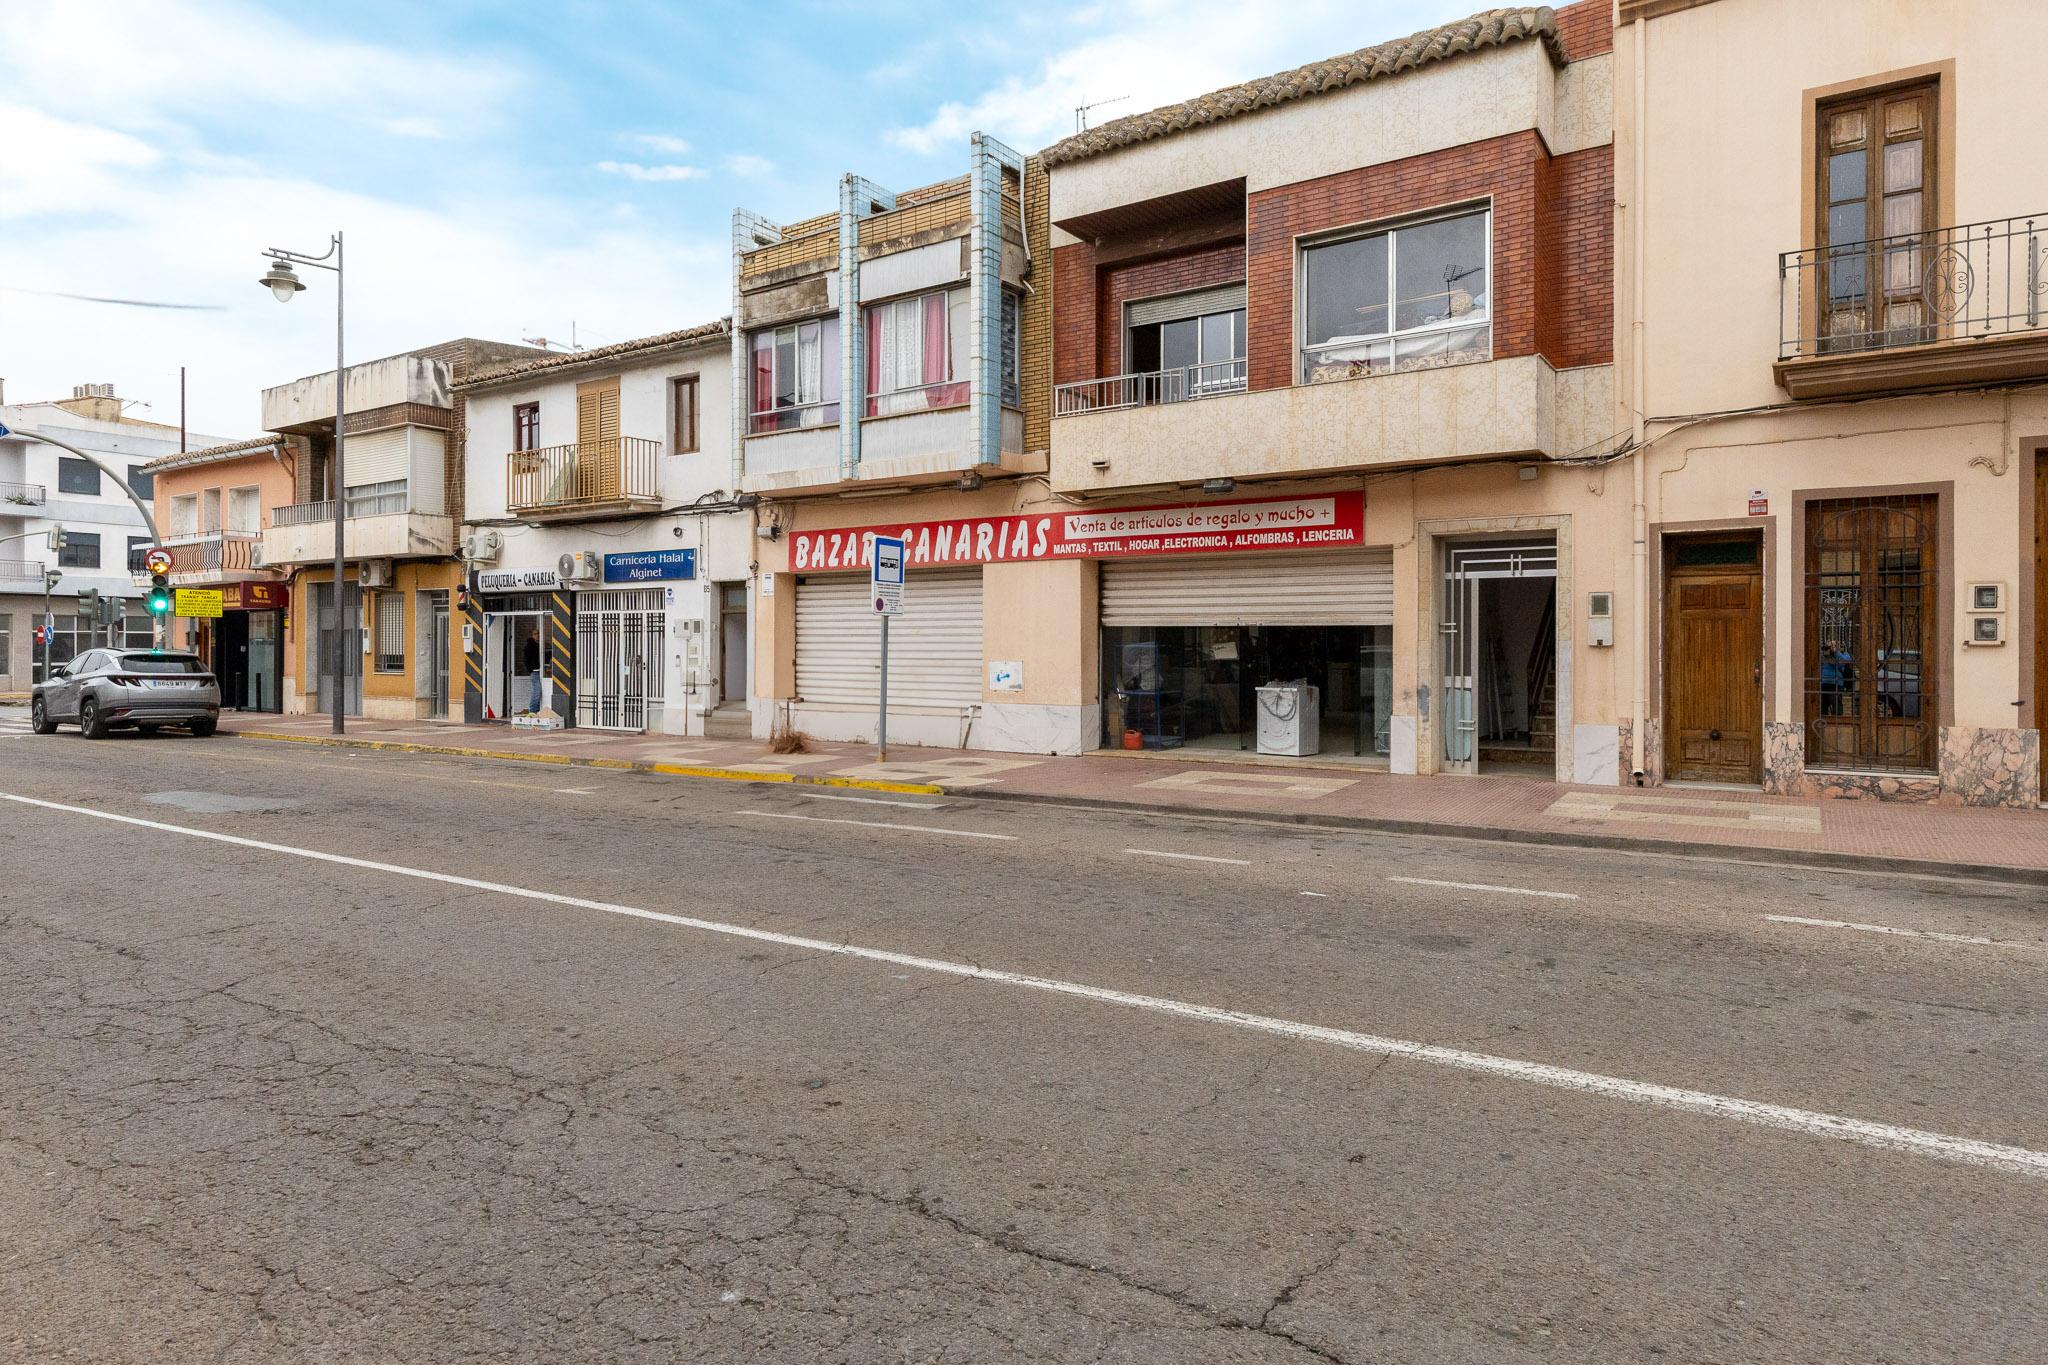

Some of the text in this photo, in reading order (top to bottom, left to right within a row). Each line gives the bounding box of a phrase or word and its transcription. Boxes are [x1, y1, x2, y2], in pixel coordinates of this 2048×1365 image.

[1068, 518, 1106, 534] Venta
[1110, 516, 1125, 531] de
[1128, 513, 1183, 530] articulos
[1186, 512, 1203, 526] de
[1206, 508, 1251, 529] regalo
[1254, 511, 1264, 526] y
[1267, 504, 1315, 523] mucho
[795, 518, 1053, 569] BAZAR CANARIAS
[1053, 543, 1087, 555] MANTAS
[1093, 541, 1122, 553] TEXTIL
[1129, 539, 1160, 551] HOGAR
[1235, 531, 1295, 546] ALFOMBRAS
[1302, 528, 1355, 542] LENCERIA
[609, 552, 684, 566] Carniceria Halal
[481, 574, 517, 590] PELUQUERIA
[523, 571, 556, 586] CANARIAS
[629, 567, 663, 580] Alginet
